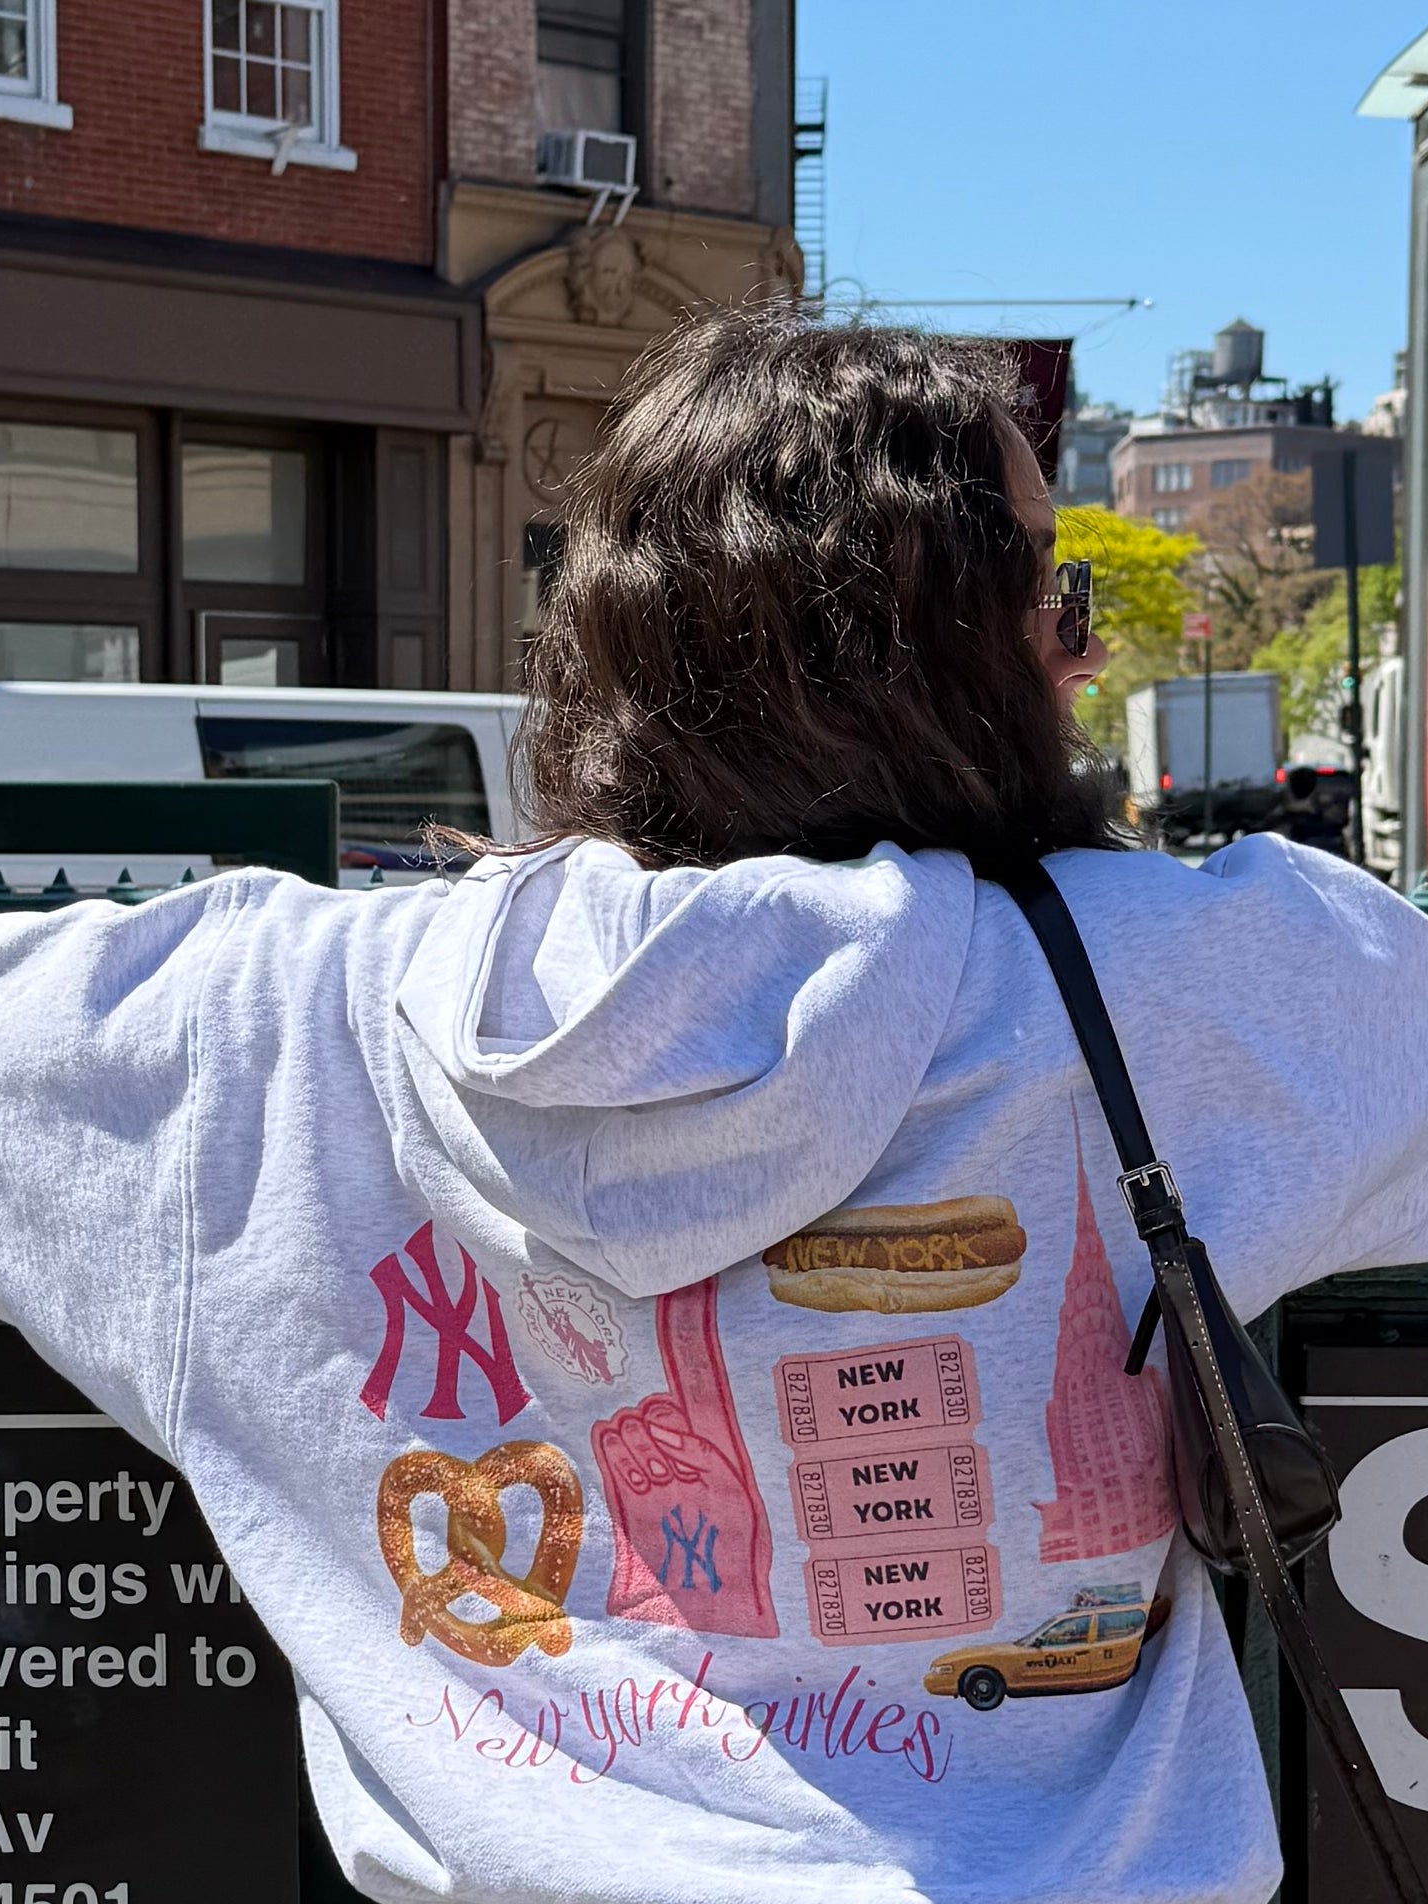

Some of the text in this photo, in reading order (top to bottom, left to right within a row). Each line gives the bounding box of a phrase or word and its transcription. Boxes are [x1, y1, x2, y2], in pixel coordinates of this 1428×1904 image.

[786, 1232, 986, 1273] NEW YORK
[359, 1219, 533, 1426] NY
[543, 1288, 582, 1302] NEW
[590, 1304, 616, 1347] YORK
[838, 1359, 904, 1389] NEW
[939, 1352, 966, 1417] 827830
[788, 1373, 815, 1435] 827830
[839, 1398, 921, 1426] YORK
[803, 1472, 829, 1533] 827830
[852, 1460, 918, 1486] NEW
[953, 1456, 978, 1520] 827830
[853, 1499, 933, 1523] YORK
[657, 1505, 722, 1594] NY
[864, 1562, 929, 1586] NEW
[818, 1570, 843, 1629] 827830
[865, 1597, 943, 1621] YORK
[966, 1556, 988, 1615] 827830
[190, 1637, 256, 1688] to
[406, 1652, 953, 1783] New york girlies
